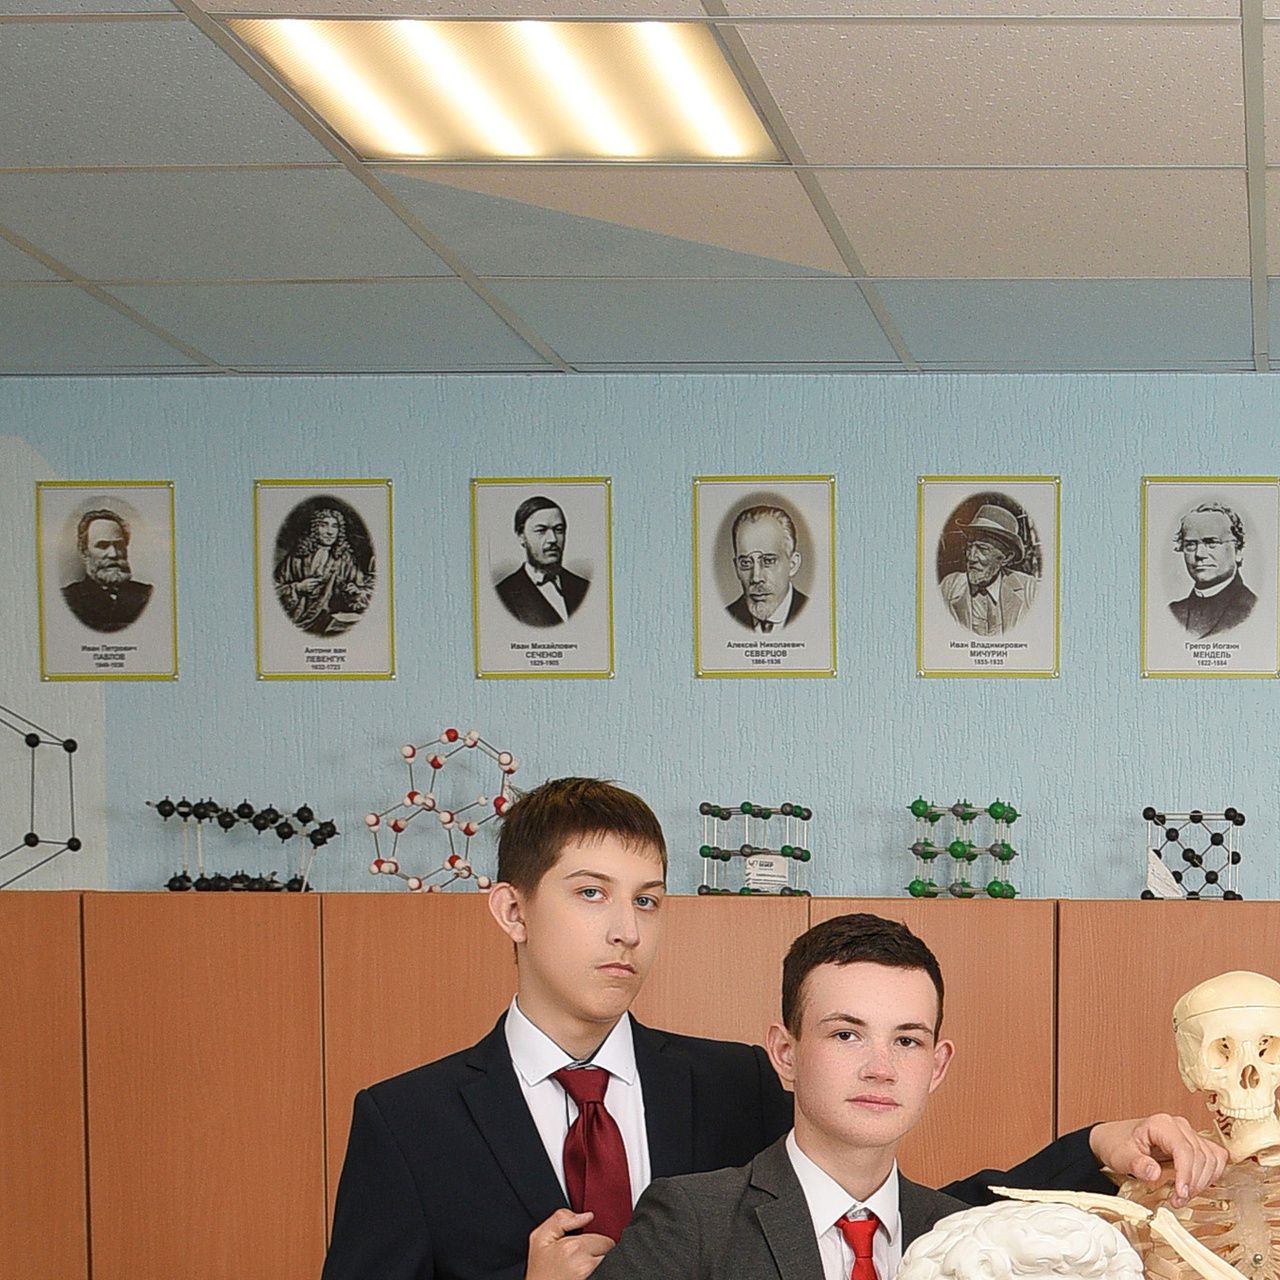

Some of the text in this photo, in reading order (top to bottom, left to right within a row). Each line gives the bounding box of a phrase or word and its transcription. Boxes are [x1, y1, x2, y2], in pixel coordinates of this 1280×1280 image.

[531, 642, 578, 650] Михайлович
[970, 641, 1028, 649] Владимирович
[93, 653, 126, 661] ПАВЛОВ
[525, 651, 563, 659] СЕЧЕНОВ
[1193, 651, 1231, 659] МЕНДЕЛЬ
